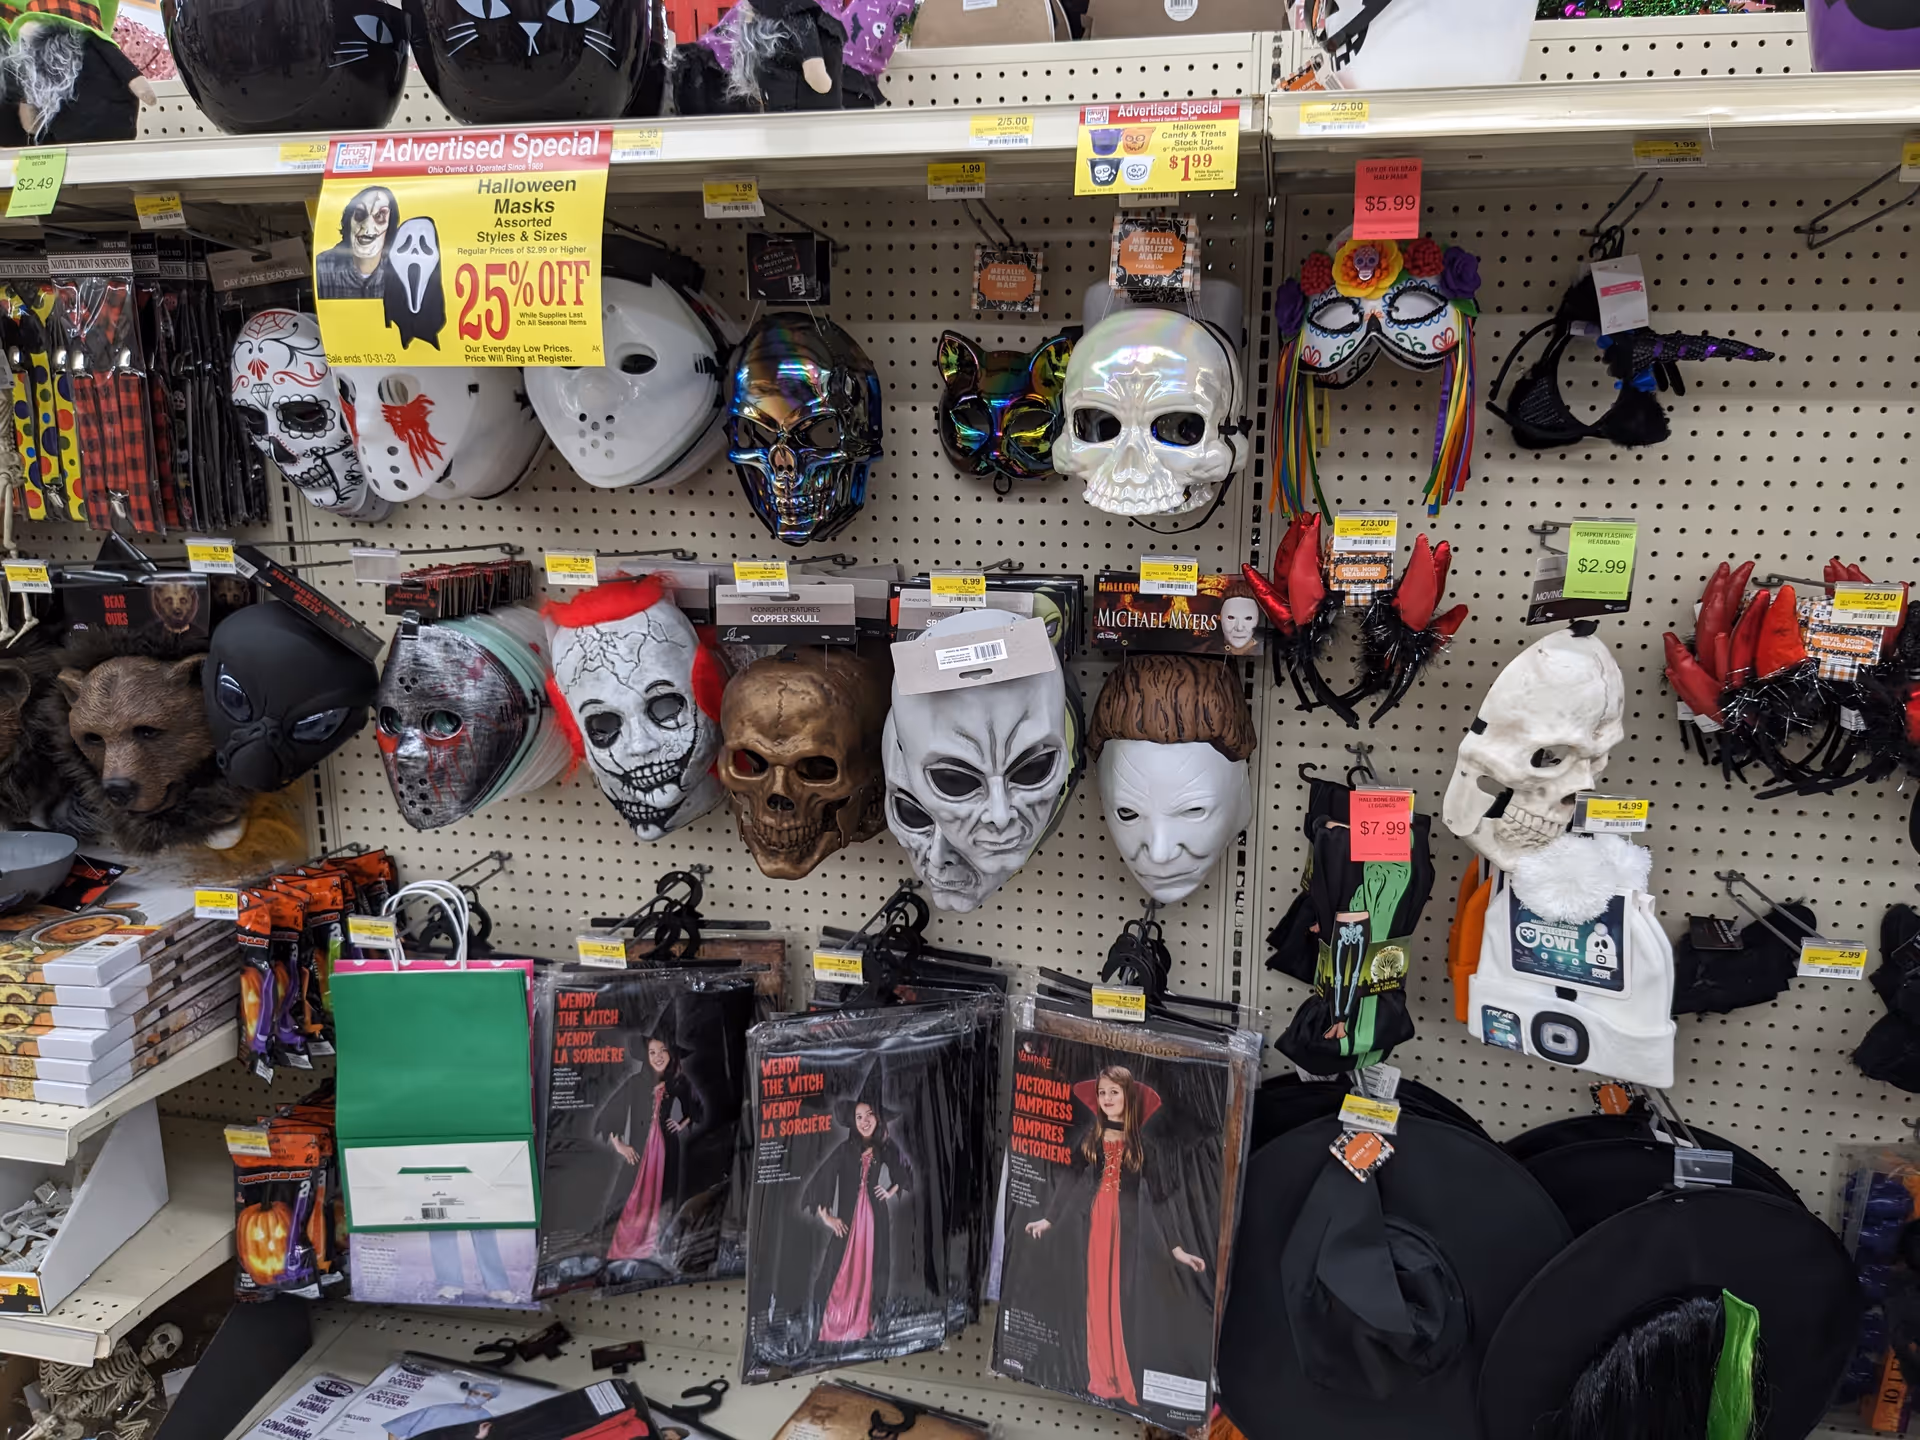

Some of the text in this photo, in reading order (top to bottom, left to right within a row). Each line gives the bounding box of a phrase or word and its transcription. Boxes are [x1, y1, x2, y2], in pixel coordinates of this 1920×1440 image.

[1118, 102, 1222, 118] Advertised Special
[1331, 102, 1364, 112] 2/5.00
[997, 117, 1028, 127] 2/5.00
[1173, 123, 1217, 131] Halloween
[1162, 131, 1188, 140] Candy
[1200, 130, 1227, 138] Treats
[309, 145, 327, 153] 2.99
[380, 130, 600, 163] Advertised Special
[1174, 139, 1213, 147] Stock Up
[341, 145, 372, 166] drug mart
[428, 162, 544, 174] Ohio Owned & Operated Since 1969
[960, 164, 980, 174] 1.99
[17, 177, 54, 191] $2.49
[478, 178, 577, 195] Halloween
[735, 183, 752, 192] 1.99
[494, 198, 556, 215] Masks
[1365, 195, 1416, 214] $5.99
[494, 216, 552, 228] Assorted
[477, 230, 568, 243] Styles & Sizes
[1132, 237, 1173, 246] METALLIC
[457, 247, 487, 257] Regular
[490, 247, 514, 256] Prices
[517, 247, 525, 255] of
[526, 246, 547, 255] $2.99
[560, 245, 587, 256] Higher
[1128, 245, 1175, 254] PEARLIZED
[1138, 252, 1163, 261] MASK
[18, 264, 30, 275] PRINT
[51, 259, 77, 270] NOVELTY
[78, 259, 94, 270] PRINT
[94, 257, 130, 270] SUSPENDERS
[223, 267, 305, 288] DAY OF THE DEAD SKULL
[990, 267, 1025, 276] METALLIC
[987, 274, 1027, 283] PEARLIZED
[455, 260, 591, 341] 25% OFF
[538, 312, 567, 321] Supplies
[569, 311, 583, 319] Last
[527, 319, 537, 327] All
[538, 319, 568, 327] Seasonal
[568, 319, 587, 327] Items
[465, 344, 573, 355] Our Everyday Low Prices.
[326, 353, 396, 364] Sale ends 10-31-23
[465, 354, 576, 365] Price Will Ring at Register.
[1173, 564, 1193, 573] 9.99
[1577, 557, 1627, 574] $2.99
[962, 578, 981, 586] 6.99
[1098, 582, 1139, 592] HALLOW
[1536, 589, 1563, 601] MOVING
[1863, 592, 1897, 601] 2/3.00
[103, 595, 126, 609] BEAR
[105, 612, 129, 626] OURS
[751, 614, 820, 623] COPPER SKULL
[1097, 607, 1218, 631] MICHAEL MYERS
[1617, 802, 1643, 810] 14.99
[1360, 820, 1406, 836] $7.99
[1541, 935, 1580, 954] OWL
[1839, 951, 1861, 959] 2.99
[558, 992, 598, 1008] WENDY
[558, 1009, 619, 1026] THE WITCH
[556, 1031, 597, 1047] WENDY
[555, 1046, 625, 1063] LA SORCIÈRE
[1018, 1050, 1053, 1070] VAMPIRE
[761, 1055, 801, 1077] WENDY
[762, 1073, 824, 1097] THE WITCH
[1016, 1072, 1071, 1101] VICTORIAN
[761, 1099, 802, 1120] WENDY
[1014, 1092, 1073, 1122] VAMPIRESS
[761, 1114, 832, 1139] LA SORCIÈRE
[1012, 1115, 1064, 1144] VAMPIRES
[1011, 1135, 1072, 1166] VICTORIENS
[296, 1400, 330, 1415] WOMAN
